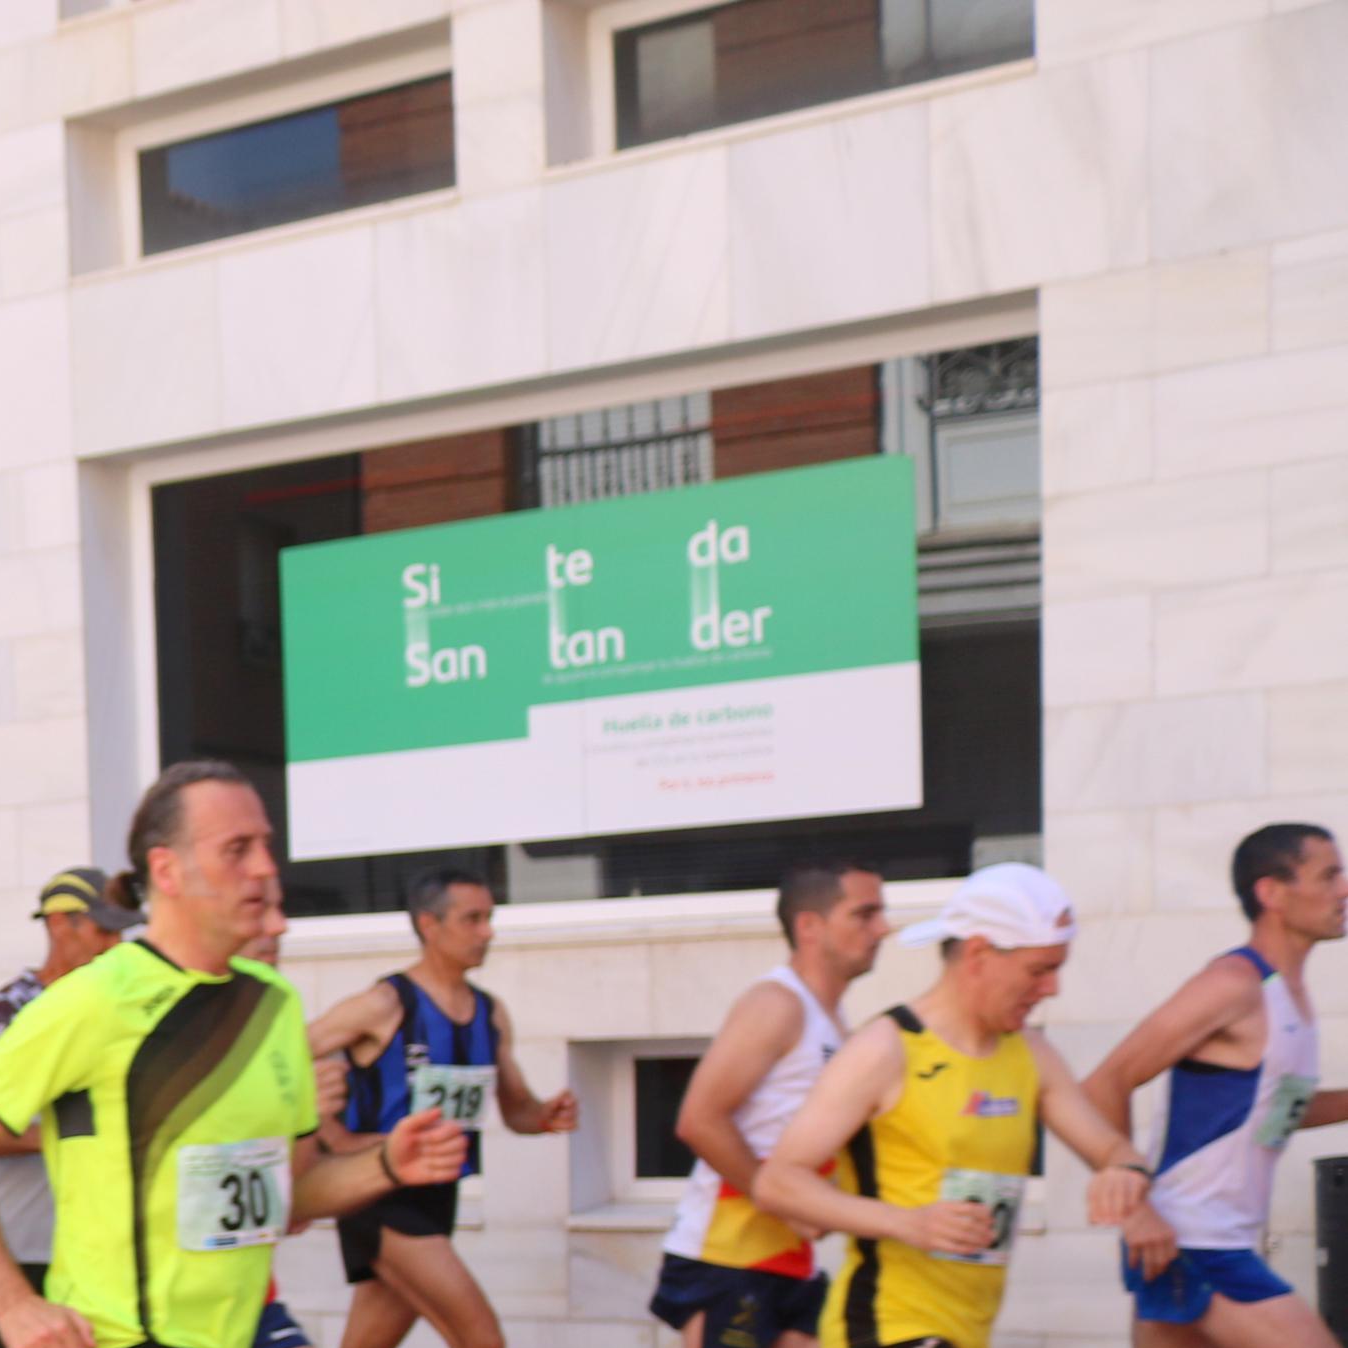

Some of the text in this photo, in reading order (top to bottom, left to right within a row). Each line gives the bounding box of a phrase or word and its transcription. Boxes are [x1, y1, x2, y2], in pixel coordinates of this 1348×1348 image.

[401, 562, 441, 609] Si
[547, 542, 594, 588] te
[687, 518, 751, 568] da
[406, 641, 488, 688] San
[550, 622, 627, 670] tan
[691, 602, 774, 651] der
[219, 1168, 269, 1231] 30
